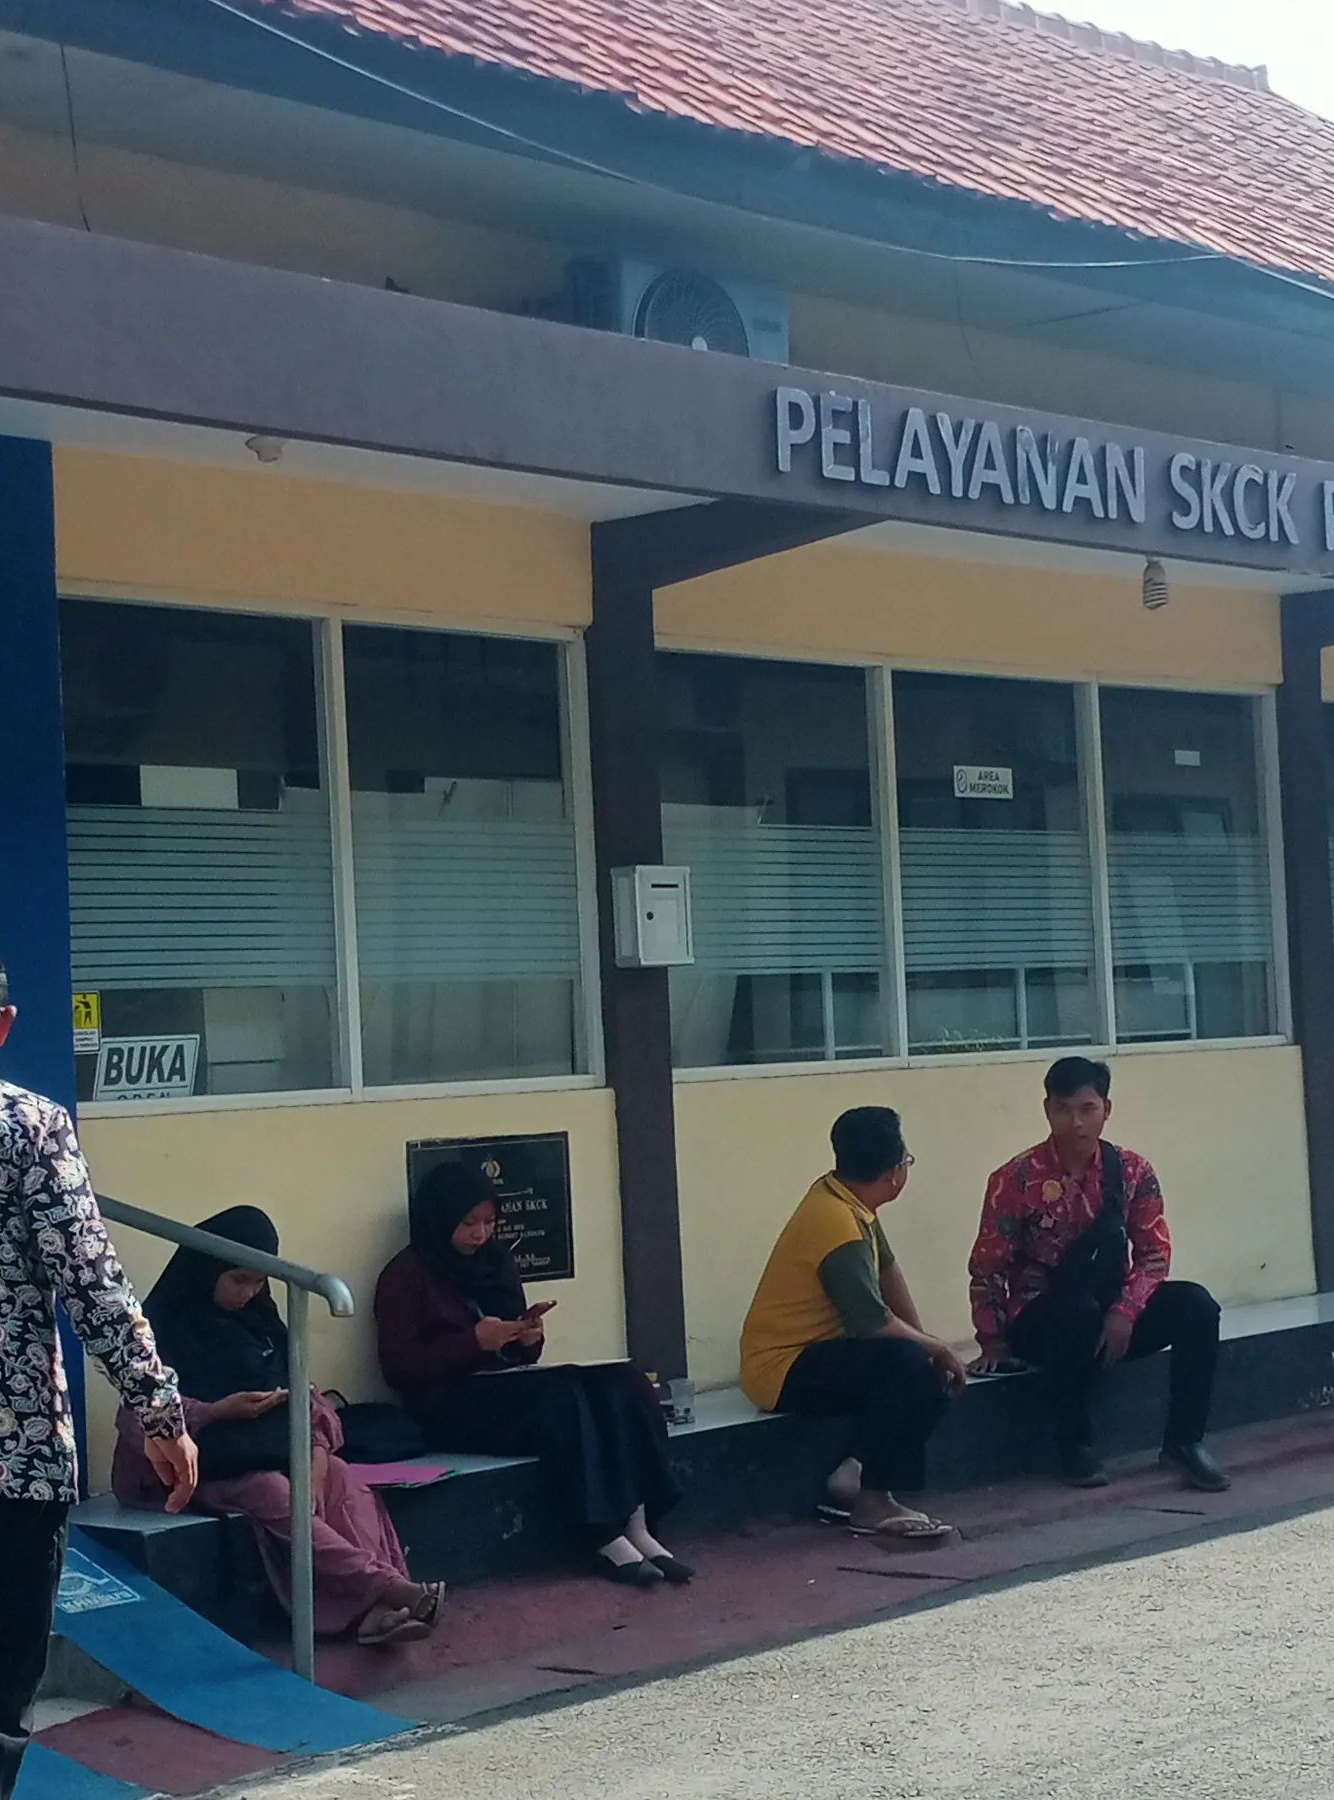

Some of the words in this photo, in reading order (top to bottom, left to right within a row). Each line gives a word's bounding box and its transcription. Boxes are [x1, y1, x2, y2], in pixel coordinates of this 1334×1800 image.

[776, 386, 1147, 525] PELAYANAN
[1170, 452, 1300, 546] SKCK
[969, 783, 1009, 794] MEROKOK
[978, 771, 1000, 781] AREA
[103, 1043, 186, 1086] BUKA
